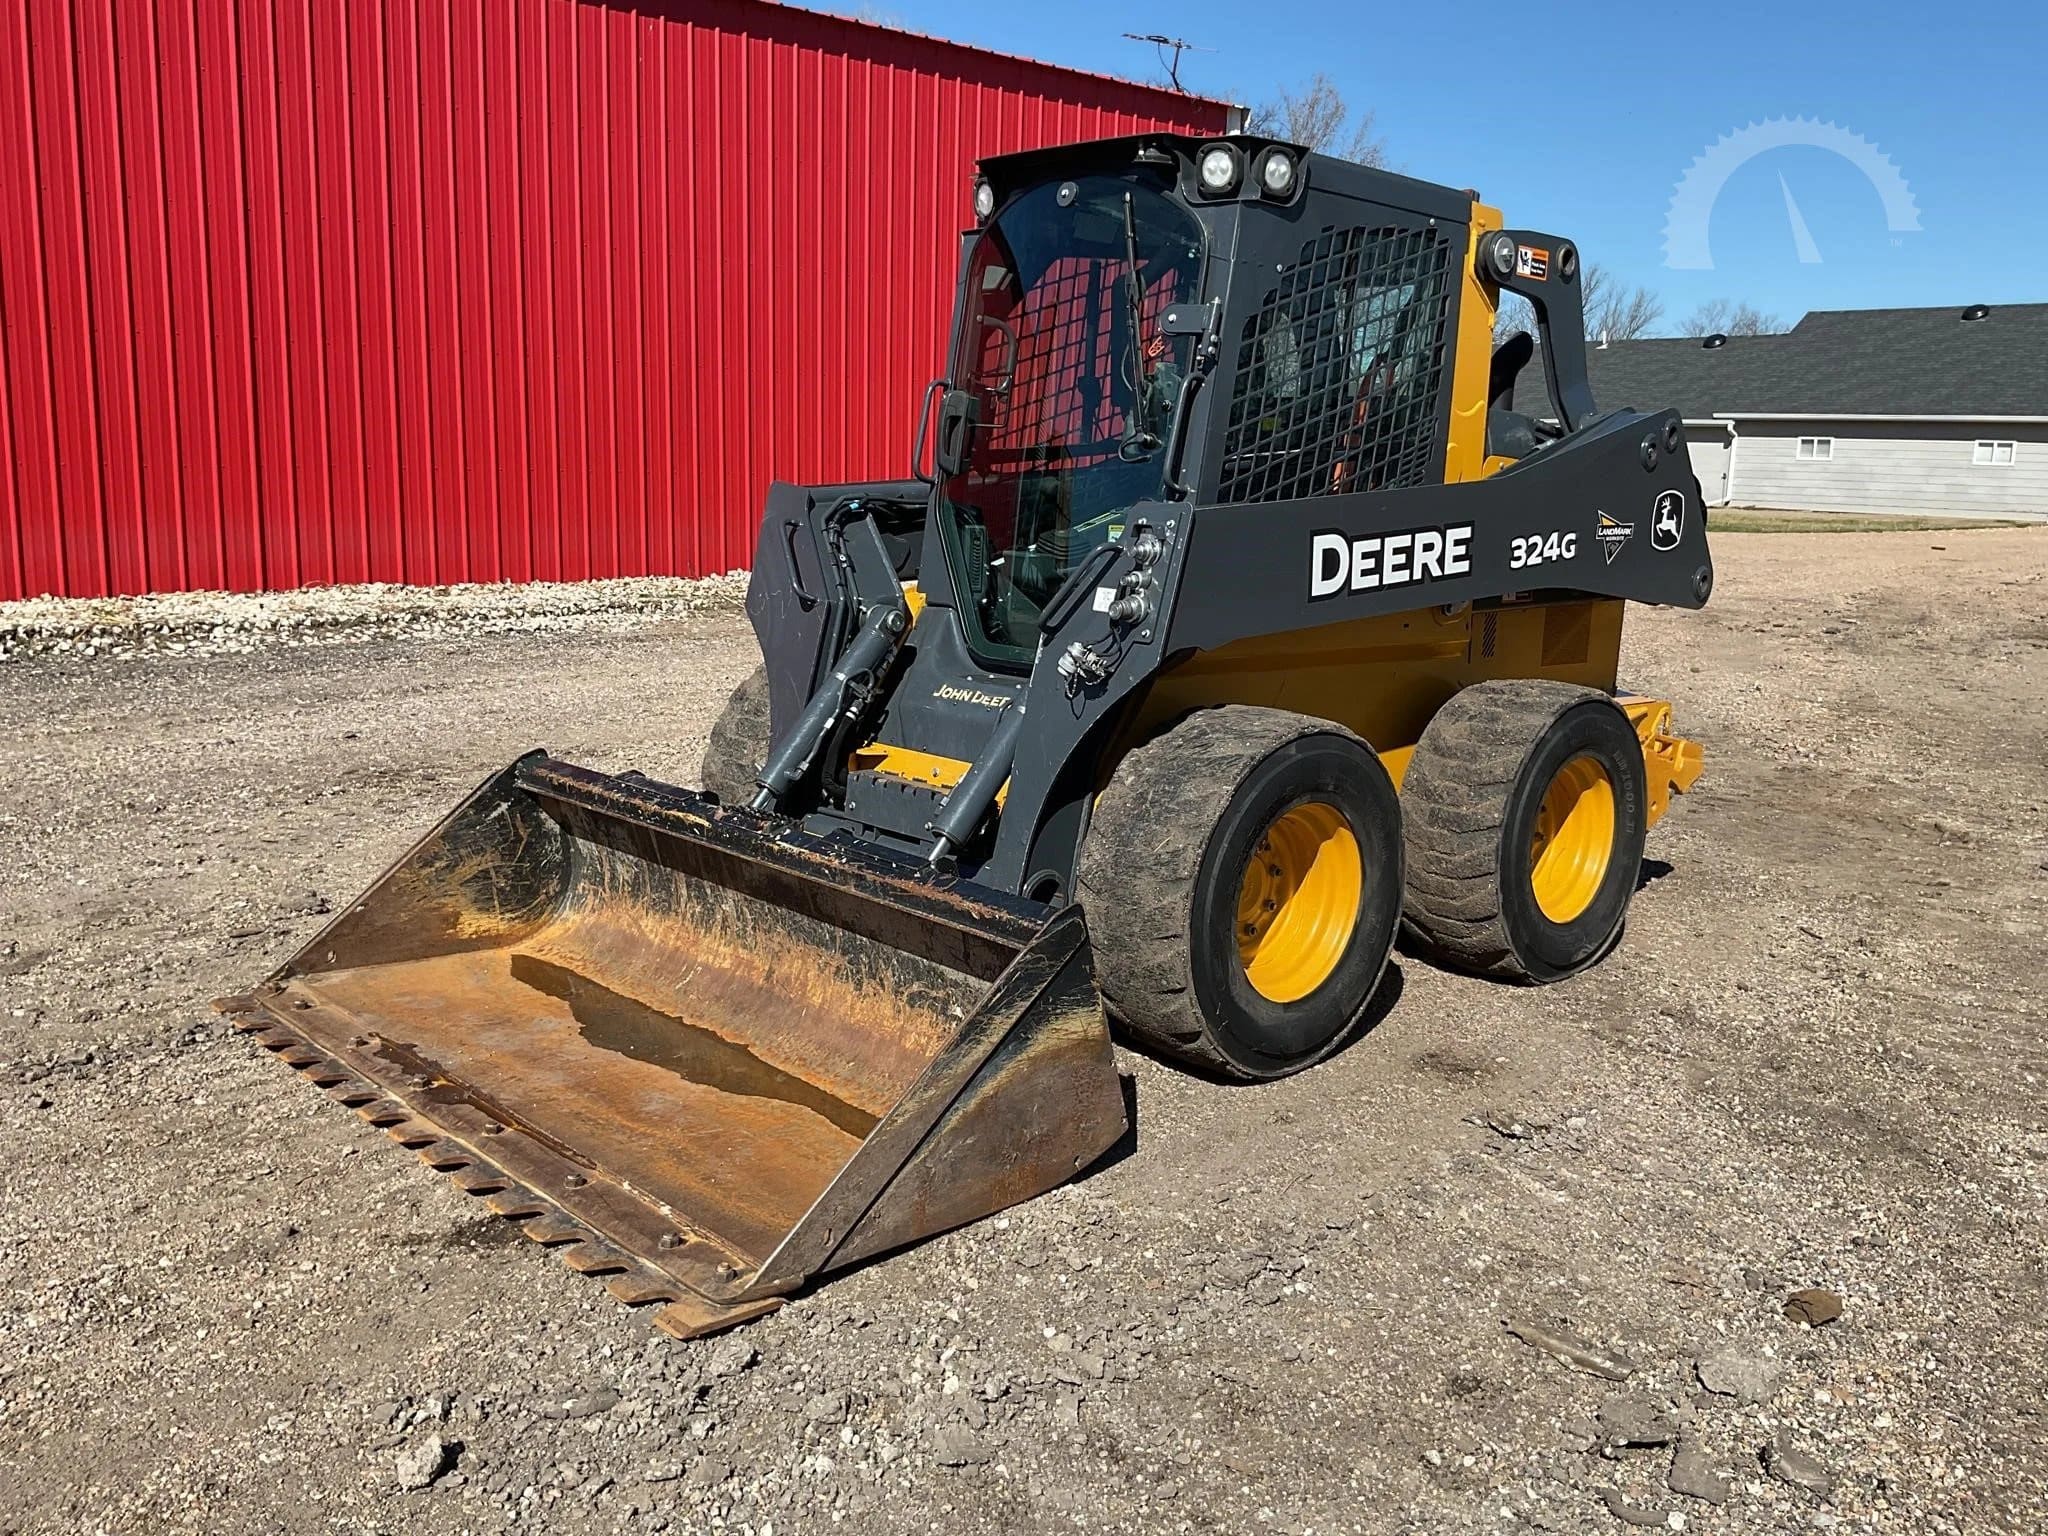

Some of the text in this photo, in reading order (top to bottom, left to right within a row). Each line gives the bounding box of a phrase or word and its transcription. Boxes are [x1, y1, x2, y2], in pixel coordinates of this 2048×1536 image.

[1311, 526, 1472, 598] DEERE
[1509, 533, 1577, 570] 324G
[933, 684, 973, 701] JOHN
